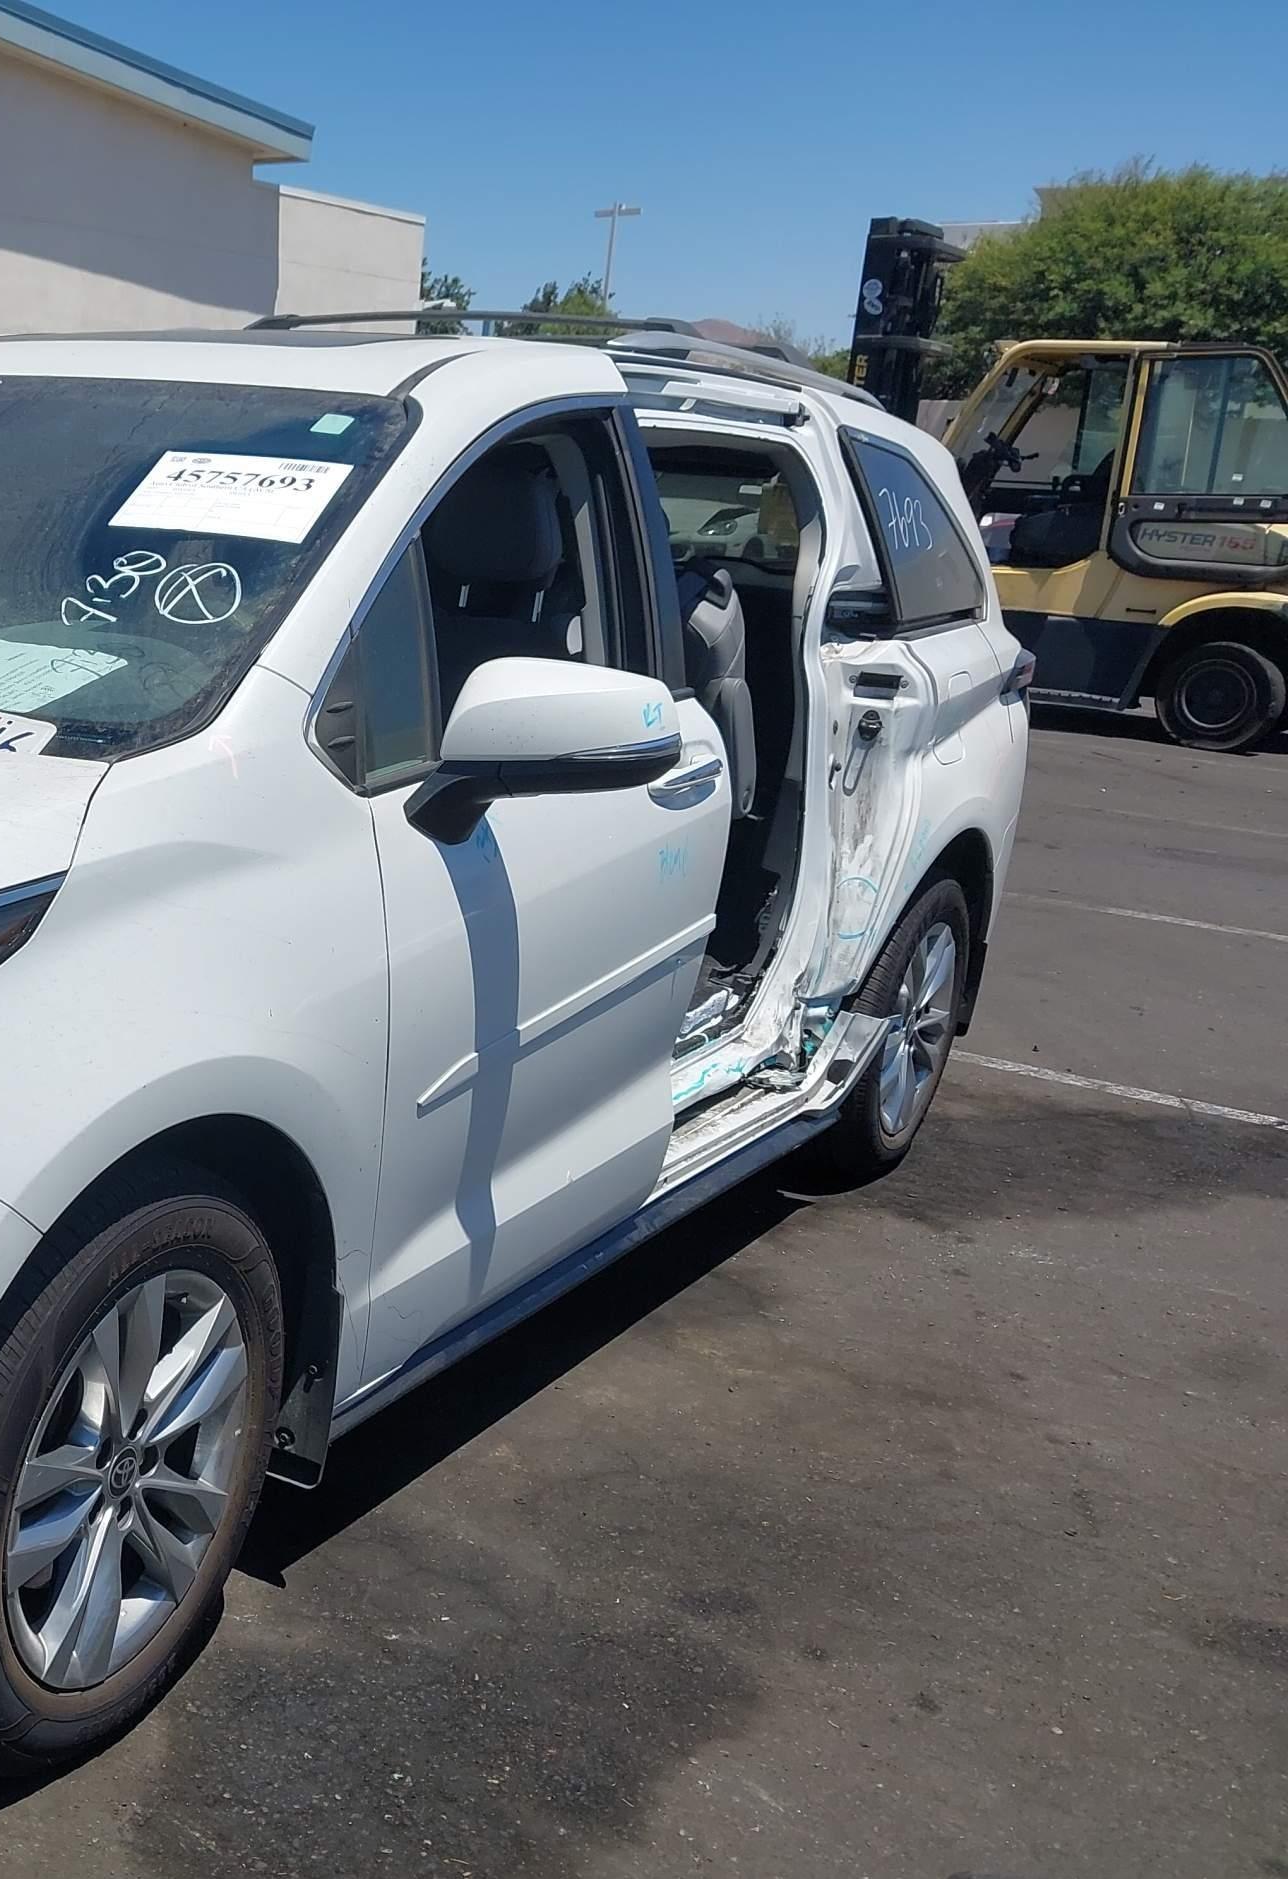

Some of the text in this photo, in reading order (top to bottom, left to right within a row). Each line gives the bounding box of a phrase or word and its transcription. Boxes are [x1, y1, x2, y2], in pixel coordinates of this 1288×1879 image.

[166, 468, 316, 492] 45757693
[878, 487, 933, 550] 7693
[1140, 528, 1216, 547] HYSTER
